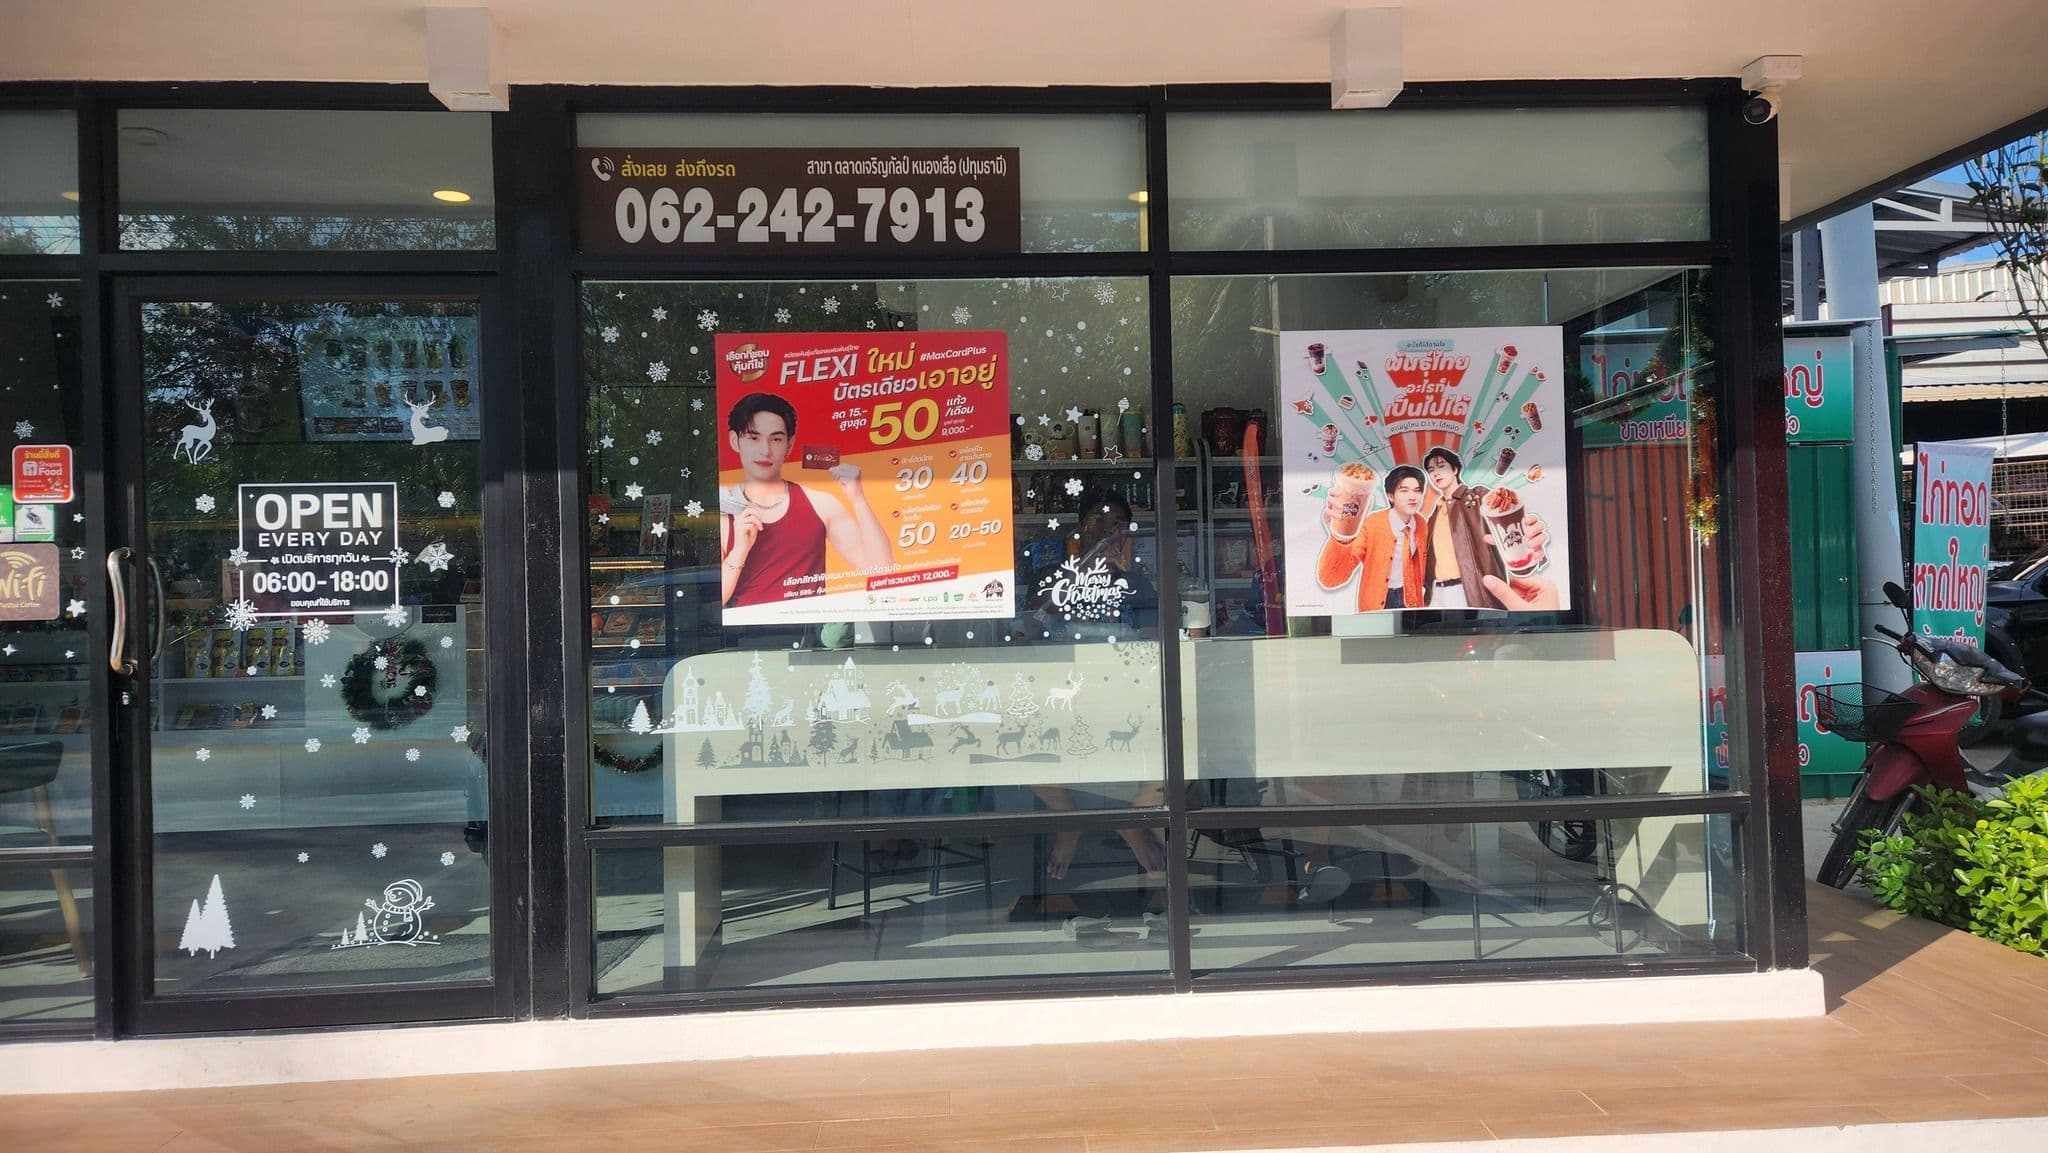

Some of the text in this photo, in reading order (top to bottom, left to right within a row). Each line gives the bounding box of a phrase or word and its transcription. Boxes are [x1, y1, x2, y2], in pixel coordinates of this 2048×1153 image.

[621, 155, 736, 177] สั่งเลย ส่งถึงรถ
[807, 159, 833, 175] สาขา
[912, 155, 956, 175] หนองเสือ
[958, 155, 1007, 180] (ปทุมธานี)
[615, 187, 985, 243] 062-242-7913
[780, 353, 858, 385] FLEXI
[867, 342, 916, 374] ใหม่
[920, 346, 987, 362] #MaxCardPlus
[1385, 349, 1471, 378] พันธุ์ไทย
[1407, 378, 1448, 393] อะไรก็
[947, 394, 967, 406] แก้ว
[1384, 393, 1472, 417] เป็นไปได้
[832, 410, 846, 420] ลด
[839, 417, 867, 432] สูงสุด
[868, 398, 940, 446] 50
[39, 467, 62, 476] Food
[895, 465, 934, 492] 30
[950, 460, 988, 486] 40
[1919, 451, 1988, 526] ไก่ทอด
[255, 493, 383, 530] OPEN
[258, 531, 383, 547] EVERY DAY
[898, 521, 937, 548] 50
[949, 520, 1002, 540] 20-50
[281, 553, 360, 565] เปิดบริการทุกวัน
[1914, 537, 1988, 627] หาดใหญ่
